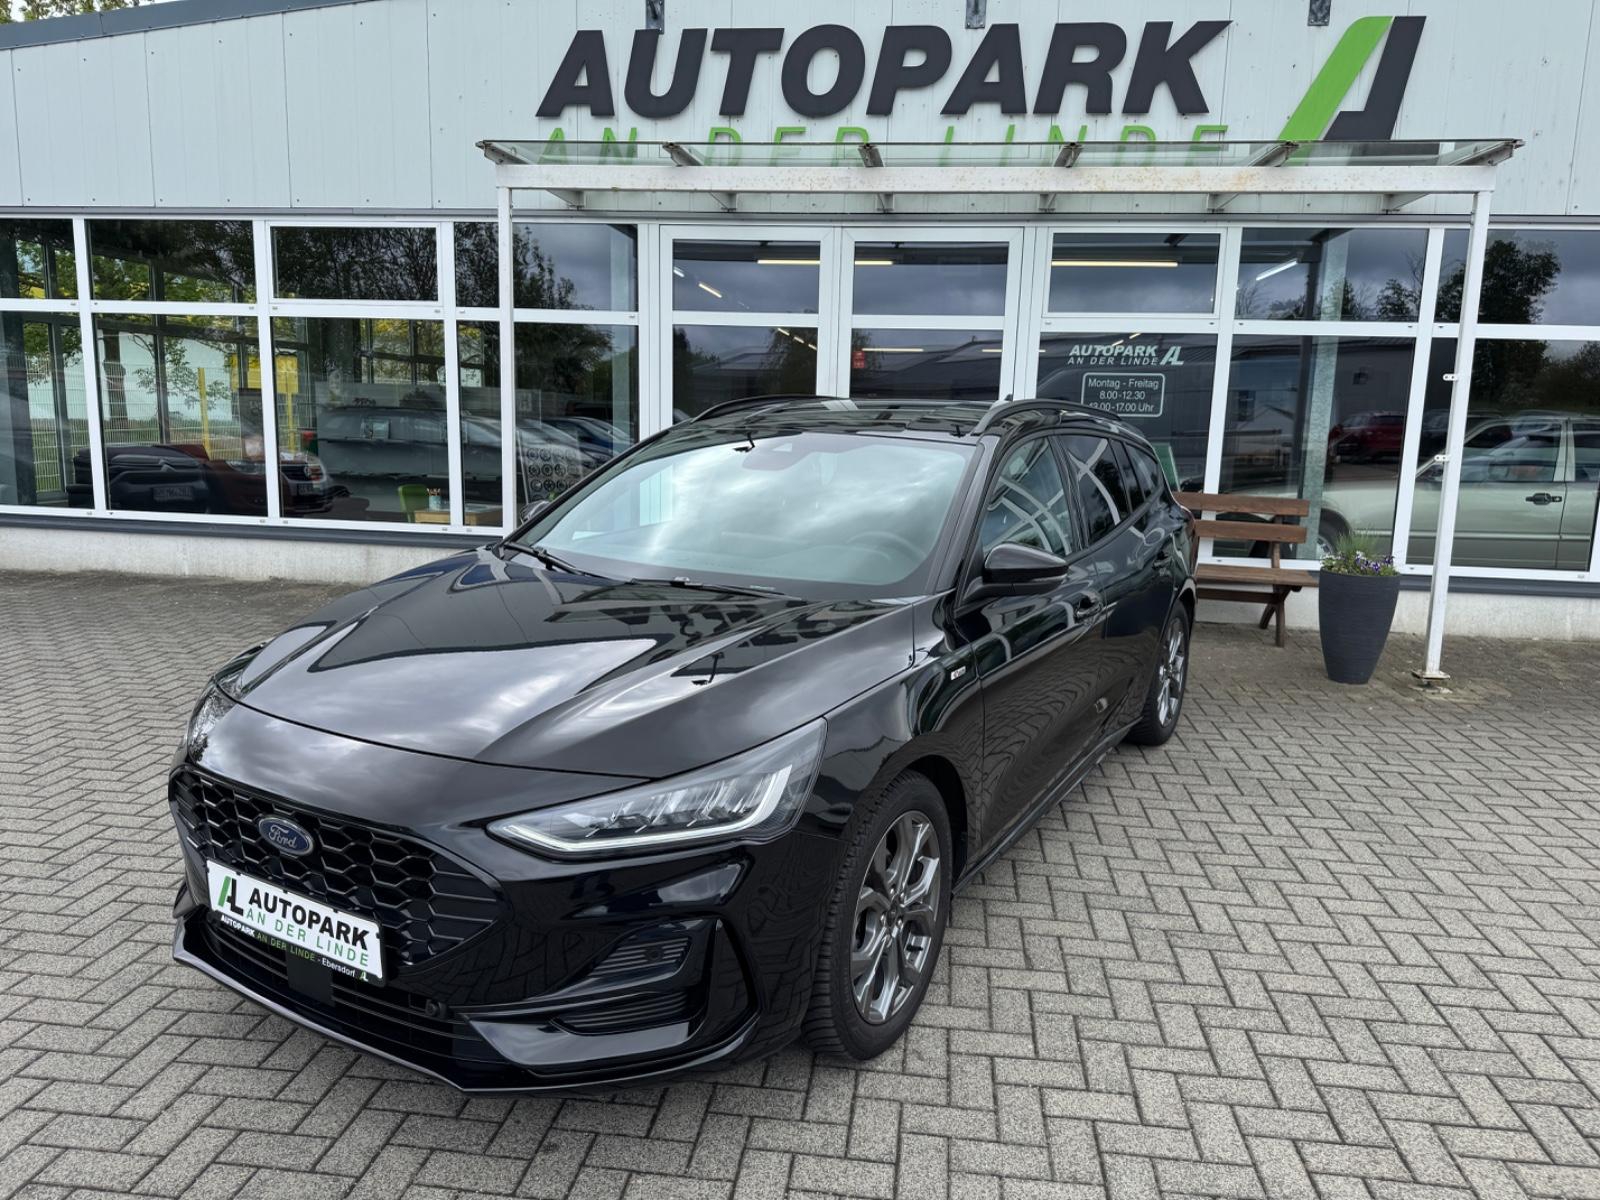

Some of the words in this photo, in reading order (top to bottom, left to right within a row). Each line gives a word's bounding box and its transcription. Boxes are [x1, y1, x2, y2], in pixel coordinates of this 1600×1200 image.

[536, 20, 1233, 118] AUTOPARK
[538, 127, 638, 165] AN
[1067, 356, 1084, 365] AN
[1090, 356, 1115, 365] DER
[1120, 357, 1158, 366] LINDE
[1069, 345, 1158, 356] AUTOPARK
[1088, 378, 1120, 389] Montag
[1128, 378, 1159, 390] Freitag
[1138, 402, 1154, 412] Uhr
[268, 825, 298, 849] Ford
[249, 887, 369, 950] AUTOPARK
[220, 914, 255, 937] AUTOPARK
[257, 932, 268, 943] AN
[270, 937, 287, 951] DER
[290, 944, 316, 962] LINDE
[321, 957, 355, 978] Ebersdorf
[247, 908, 266, 926] AN
[275, 919, 306, 942] DER
[316, 936, 369, 967] LINDE
